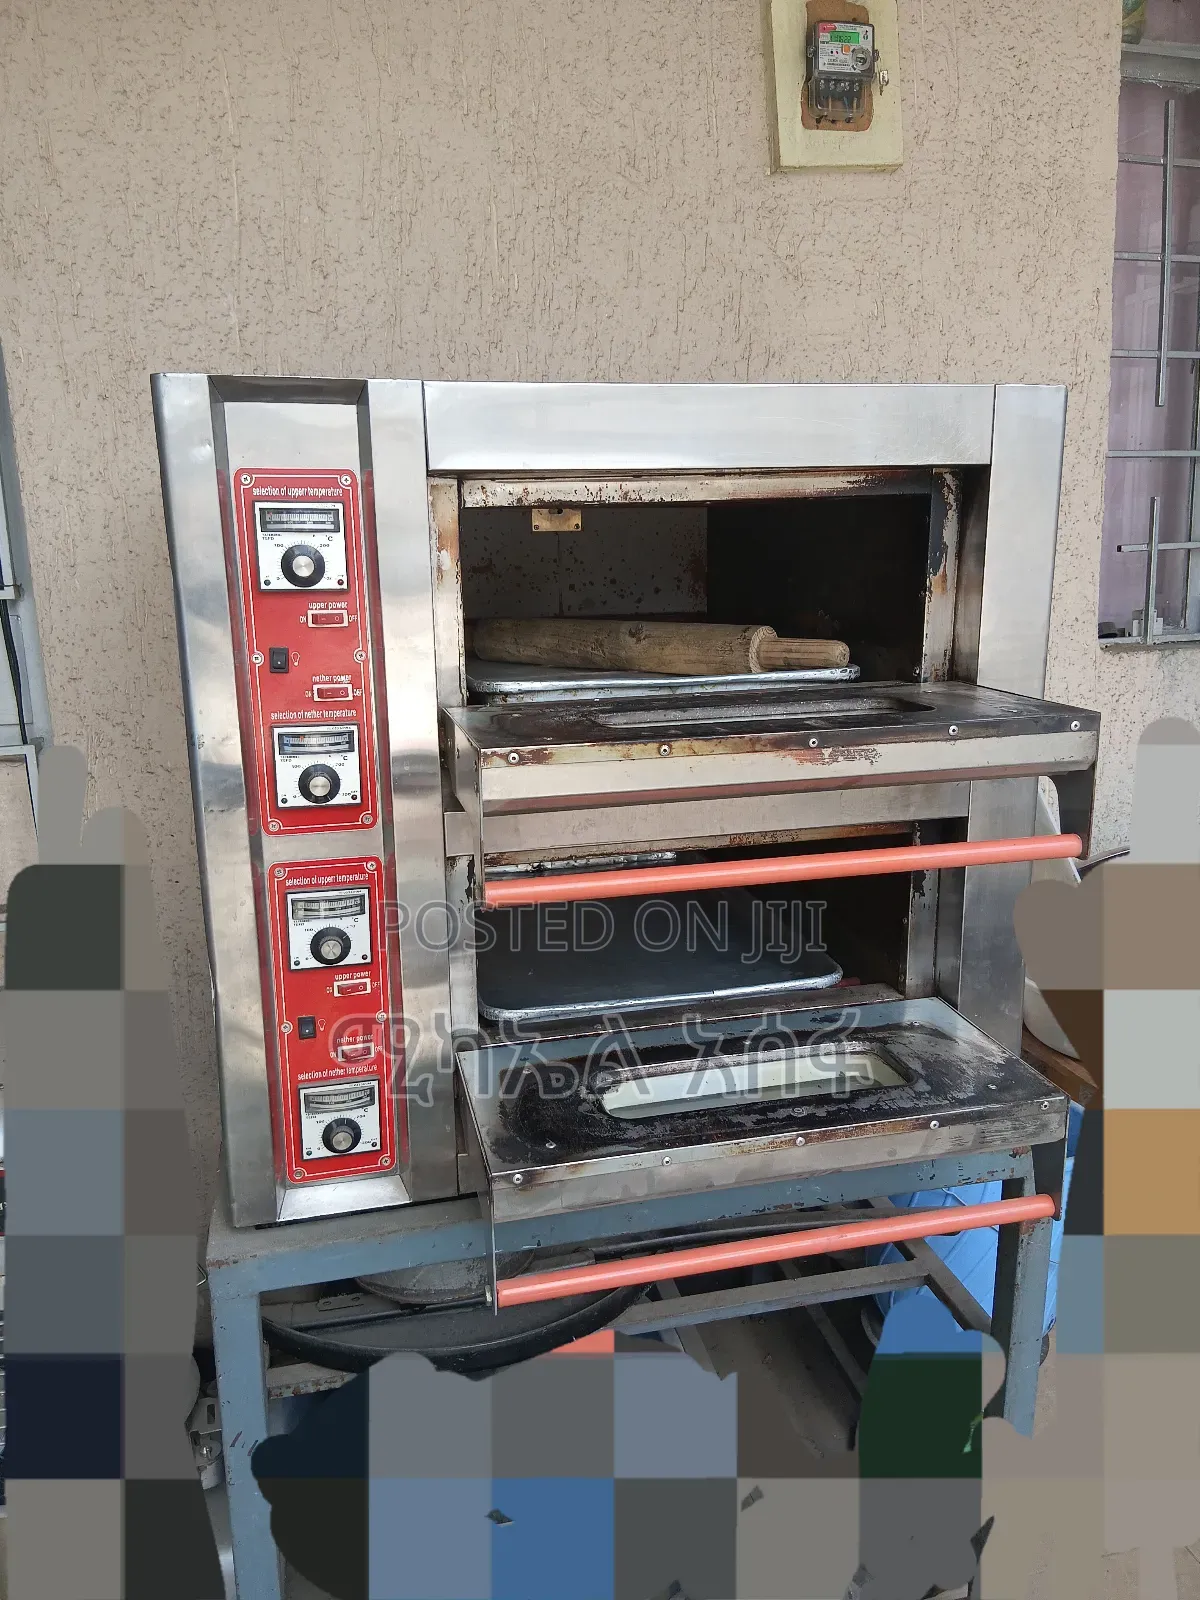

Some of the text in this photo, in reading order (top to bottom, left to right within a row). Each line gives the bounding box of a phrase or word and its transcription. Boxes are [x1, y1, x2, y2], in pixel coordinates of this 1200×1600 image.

[252, 485, 280, 496] selection
[281, 485, 287, 496] of
[307, 486, 343, 499] temperature
[308, 601, 348, 610] upper power
[300, 615, 307, 623] ON
[312, 674, 352, 683] nether power
[270, 709, 357, 720] selection of nether temperature
[285, 875, 311, 887] selection
[311, 875, 317, 884] of
[336, 872, 369, 883] temperature
[334, 971, 371, 980] upper power
[336, 1034, 374, 1044] nether power
[297, 1069, 322, 1081] selection
[322, 1069, 328, 1078] of
[346, 1064, 378, 1075] temperature
